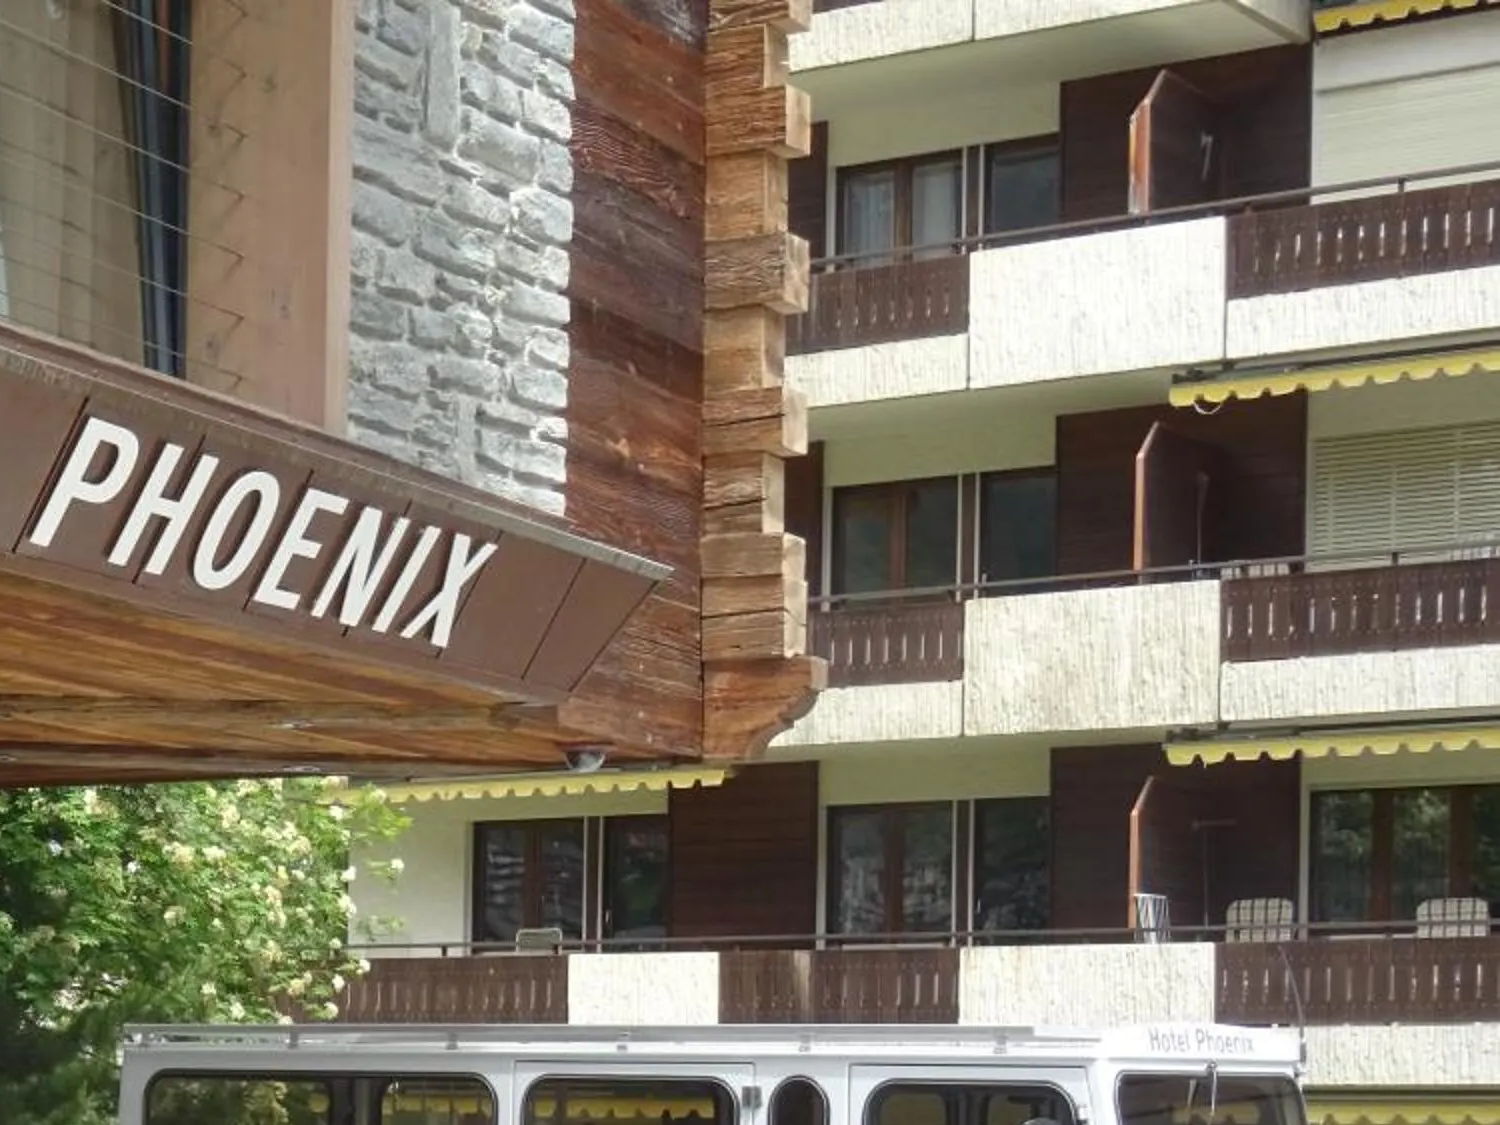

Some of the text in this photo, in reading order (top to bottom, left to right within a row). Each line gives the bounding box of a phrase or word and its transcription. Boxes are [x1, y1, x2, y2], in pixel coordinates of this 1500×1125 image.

[27, 415, 498, 648] PHOENIX
[1150, 1028, 1254, 1053] Hotel Phoenix
